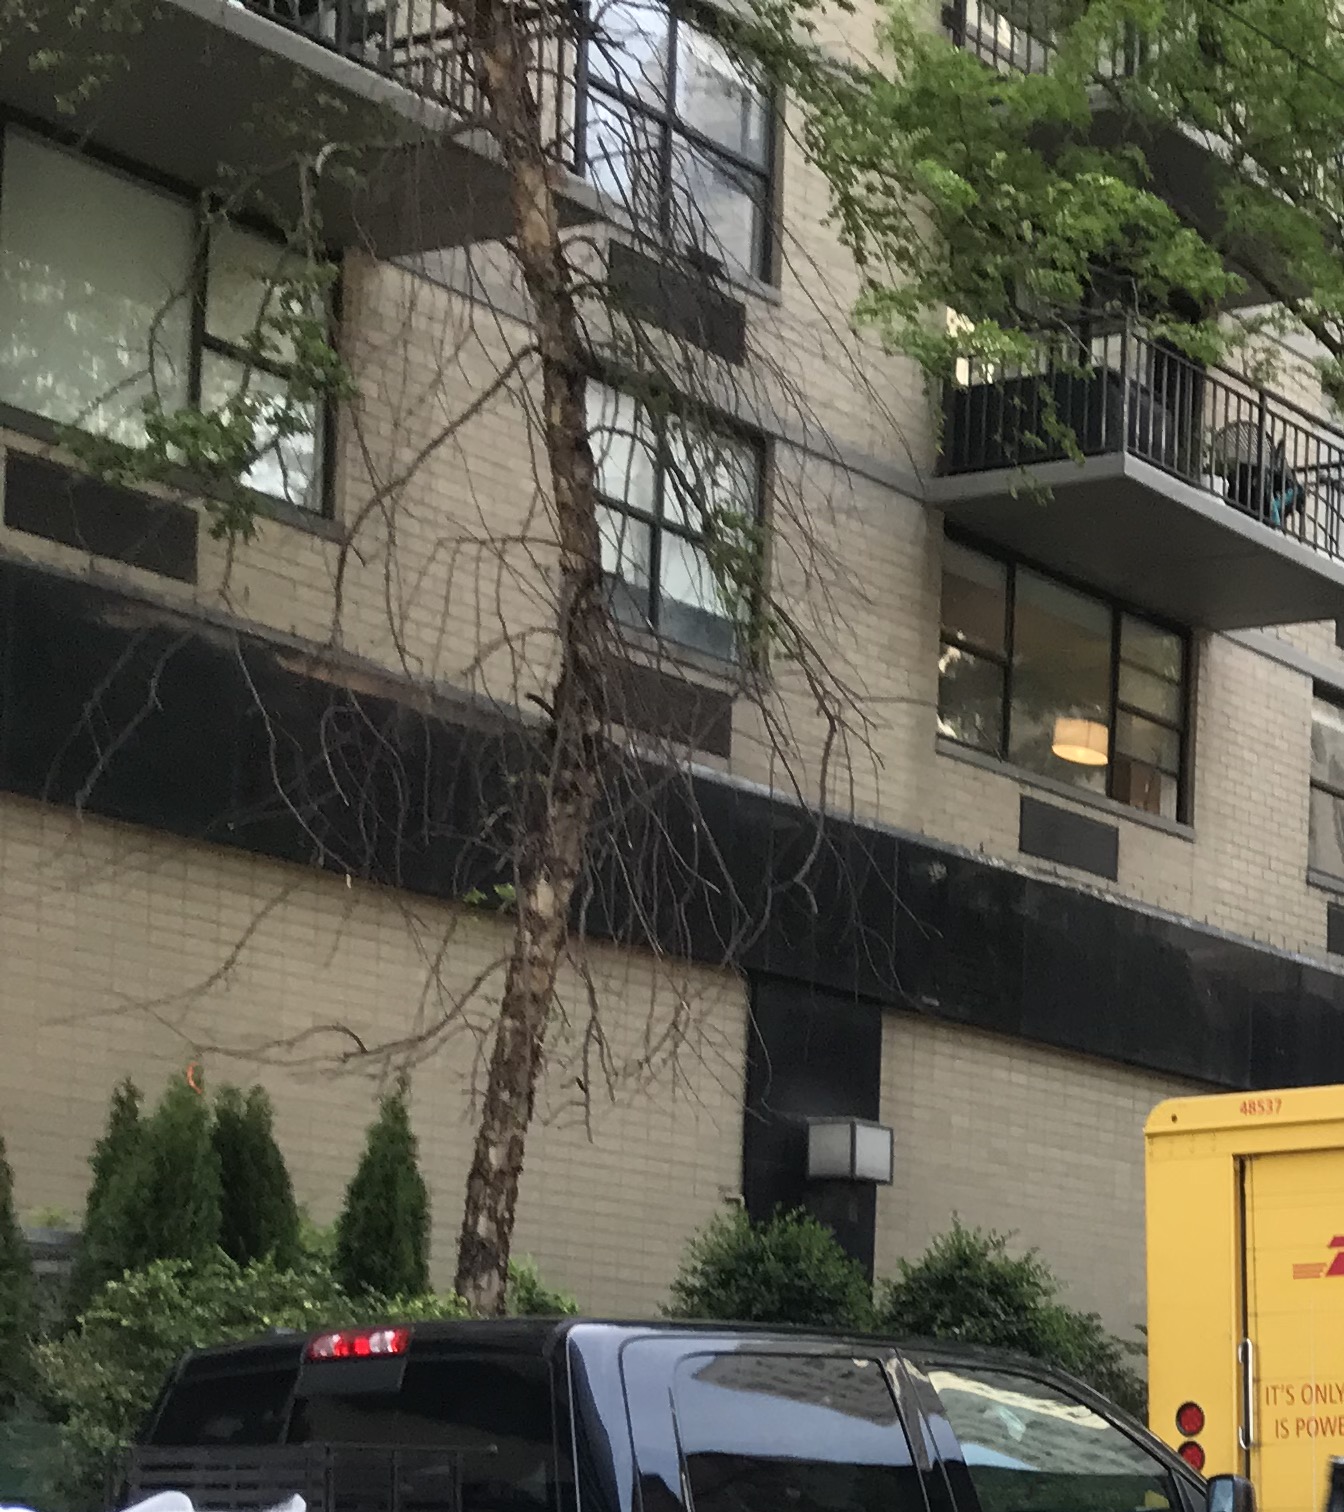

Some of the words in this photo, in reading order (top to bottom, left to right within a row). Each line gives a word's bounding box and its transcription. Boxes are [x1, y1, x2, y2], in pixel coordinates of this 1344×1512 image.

[1239, 1097, 1283, 1117] 48537
[1265, 1384, 1295, 1407] IT'S
[1275, 1417, 1290, 1440] IS
